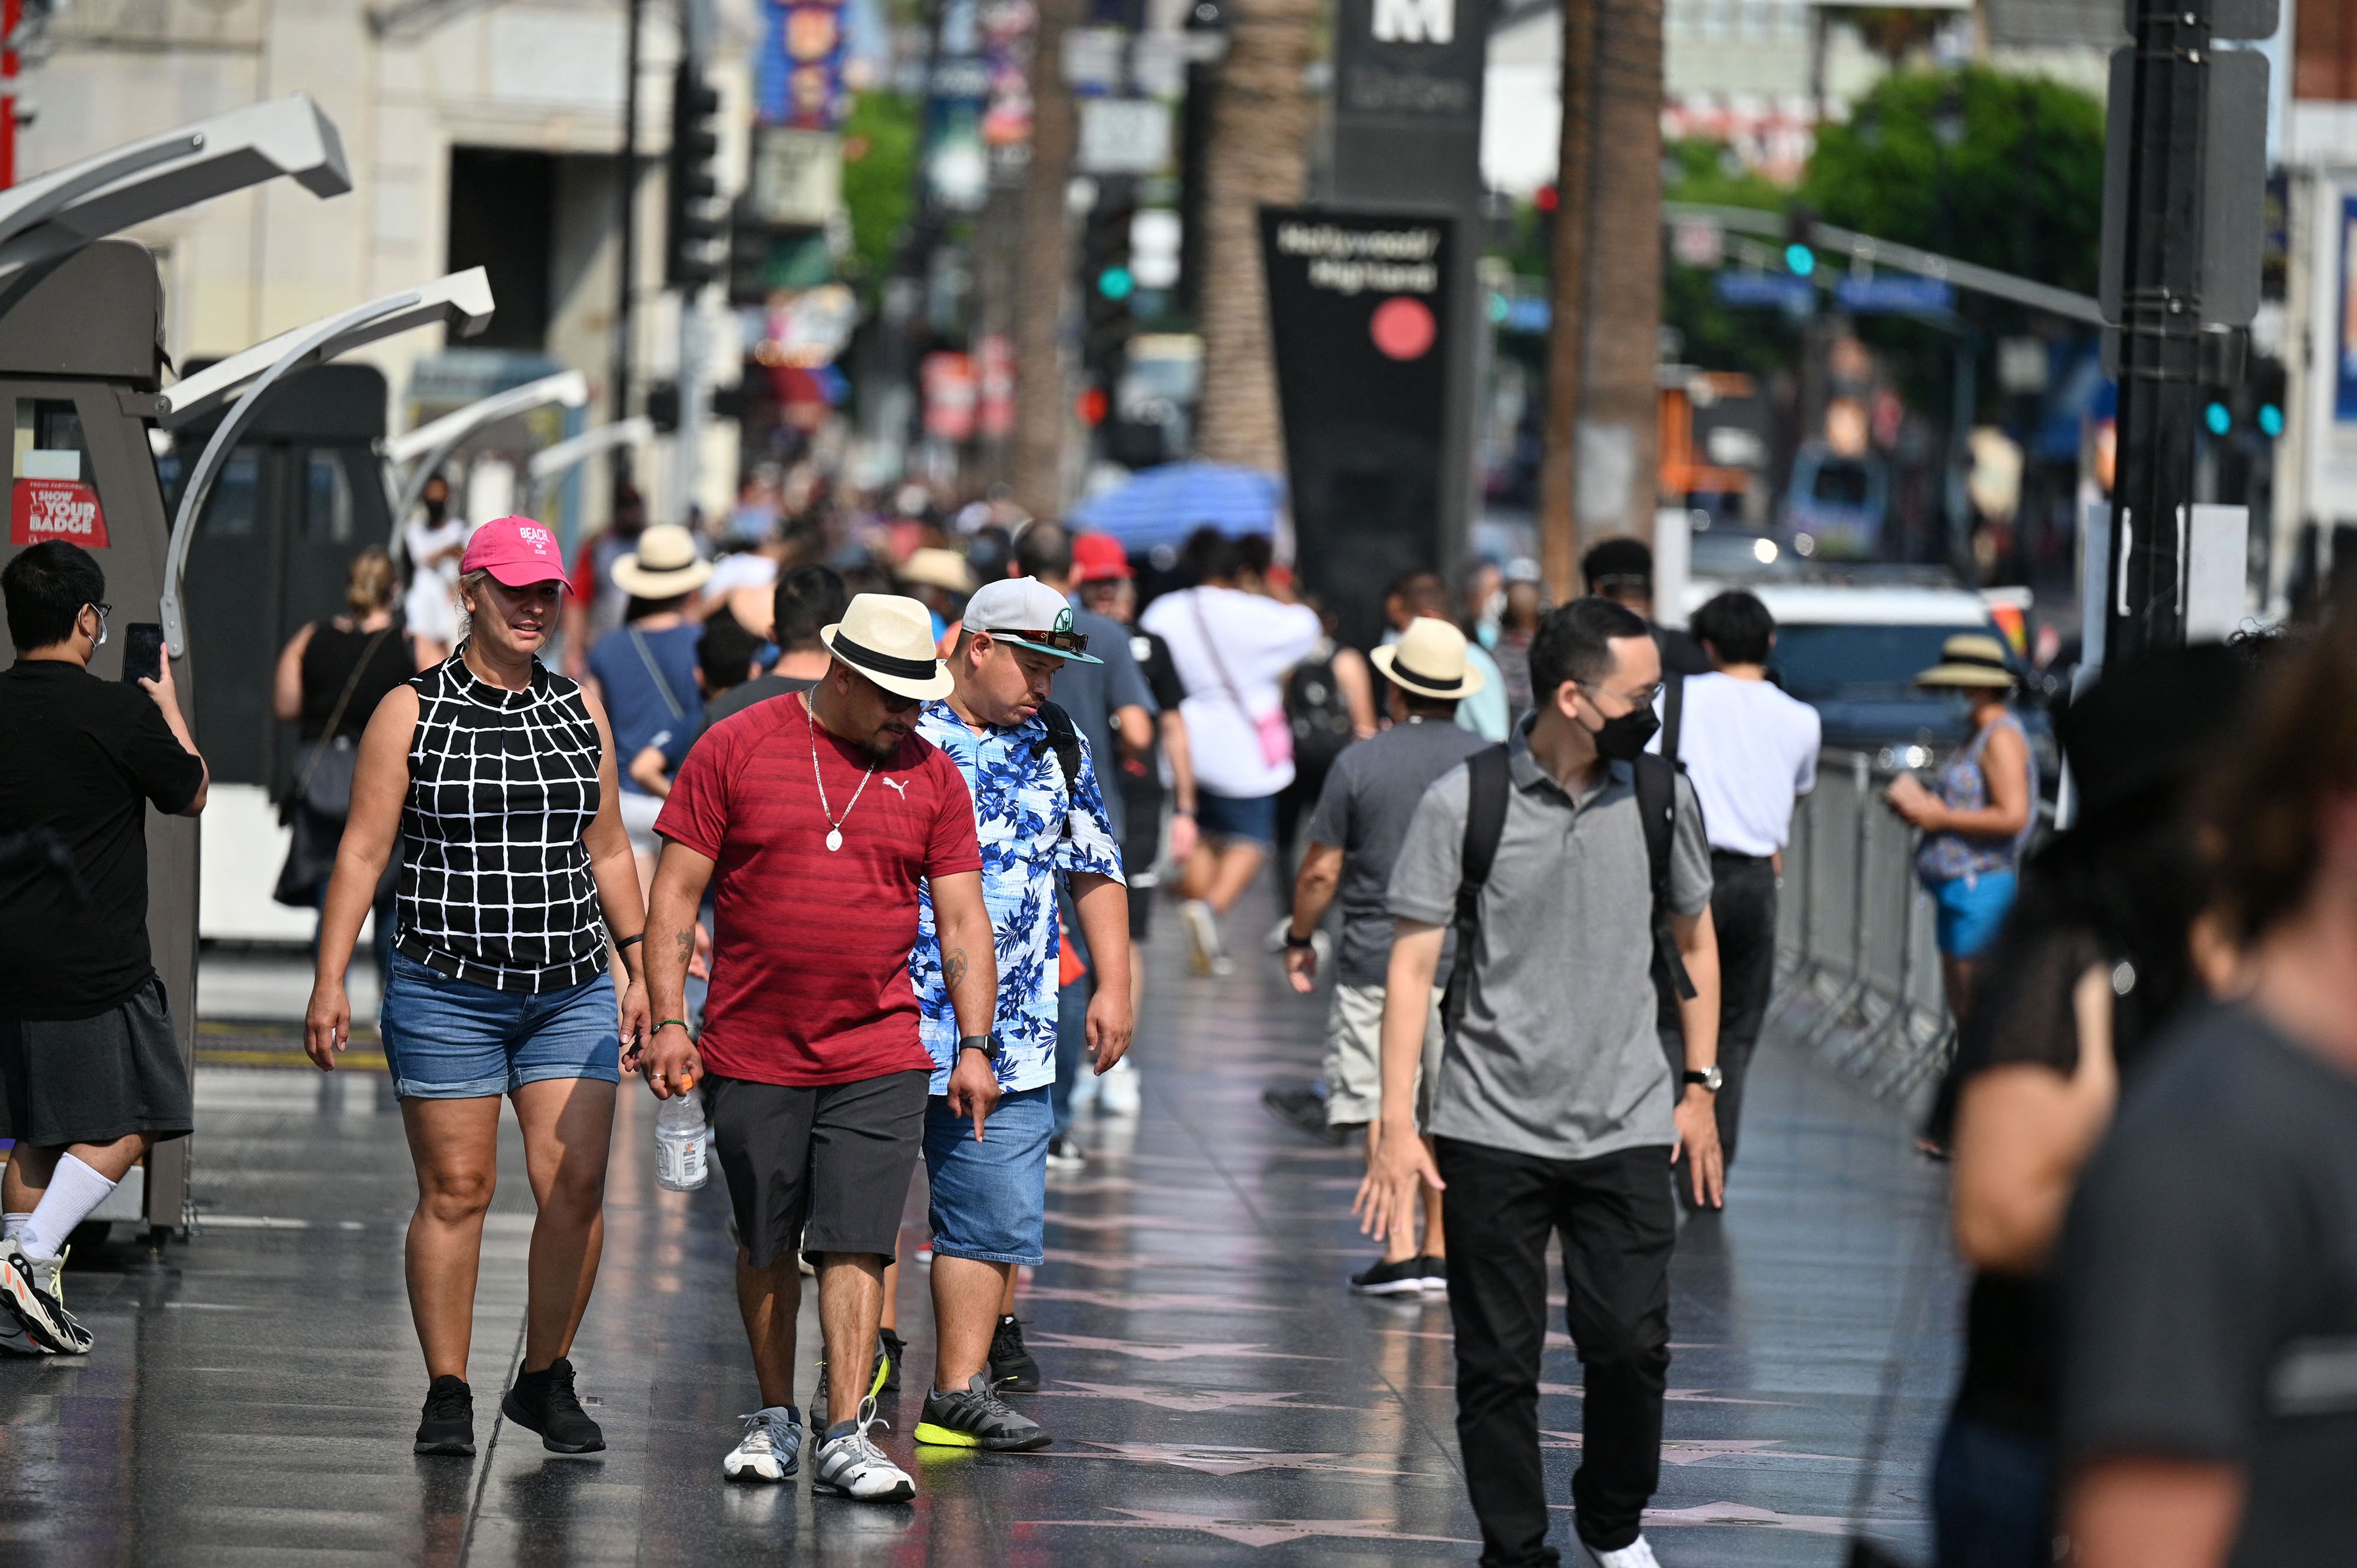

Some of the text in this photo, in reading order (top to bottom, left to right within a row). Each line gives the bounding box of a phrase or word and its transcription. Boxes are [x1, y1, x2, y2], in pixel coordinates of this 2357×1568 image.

[1372, 0, 1455, 44] M
[38, 490, 74, 502] SHOW
[44, 500, 95, 519] YOUR
[29, 514, 93, 534] BADGE
